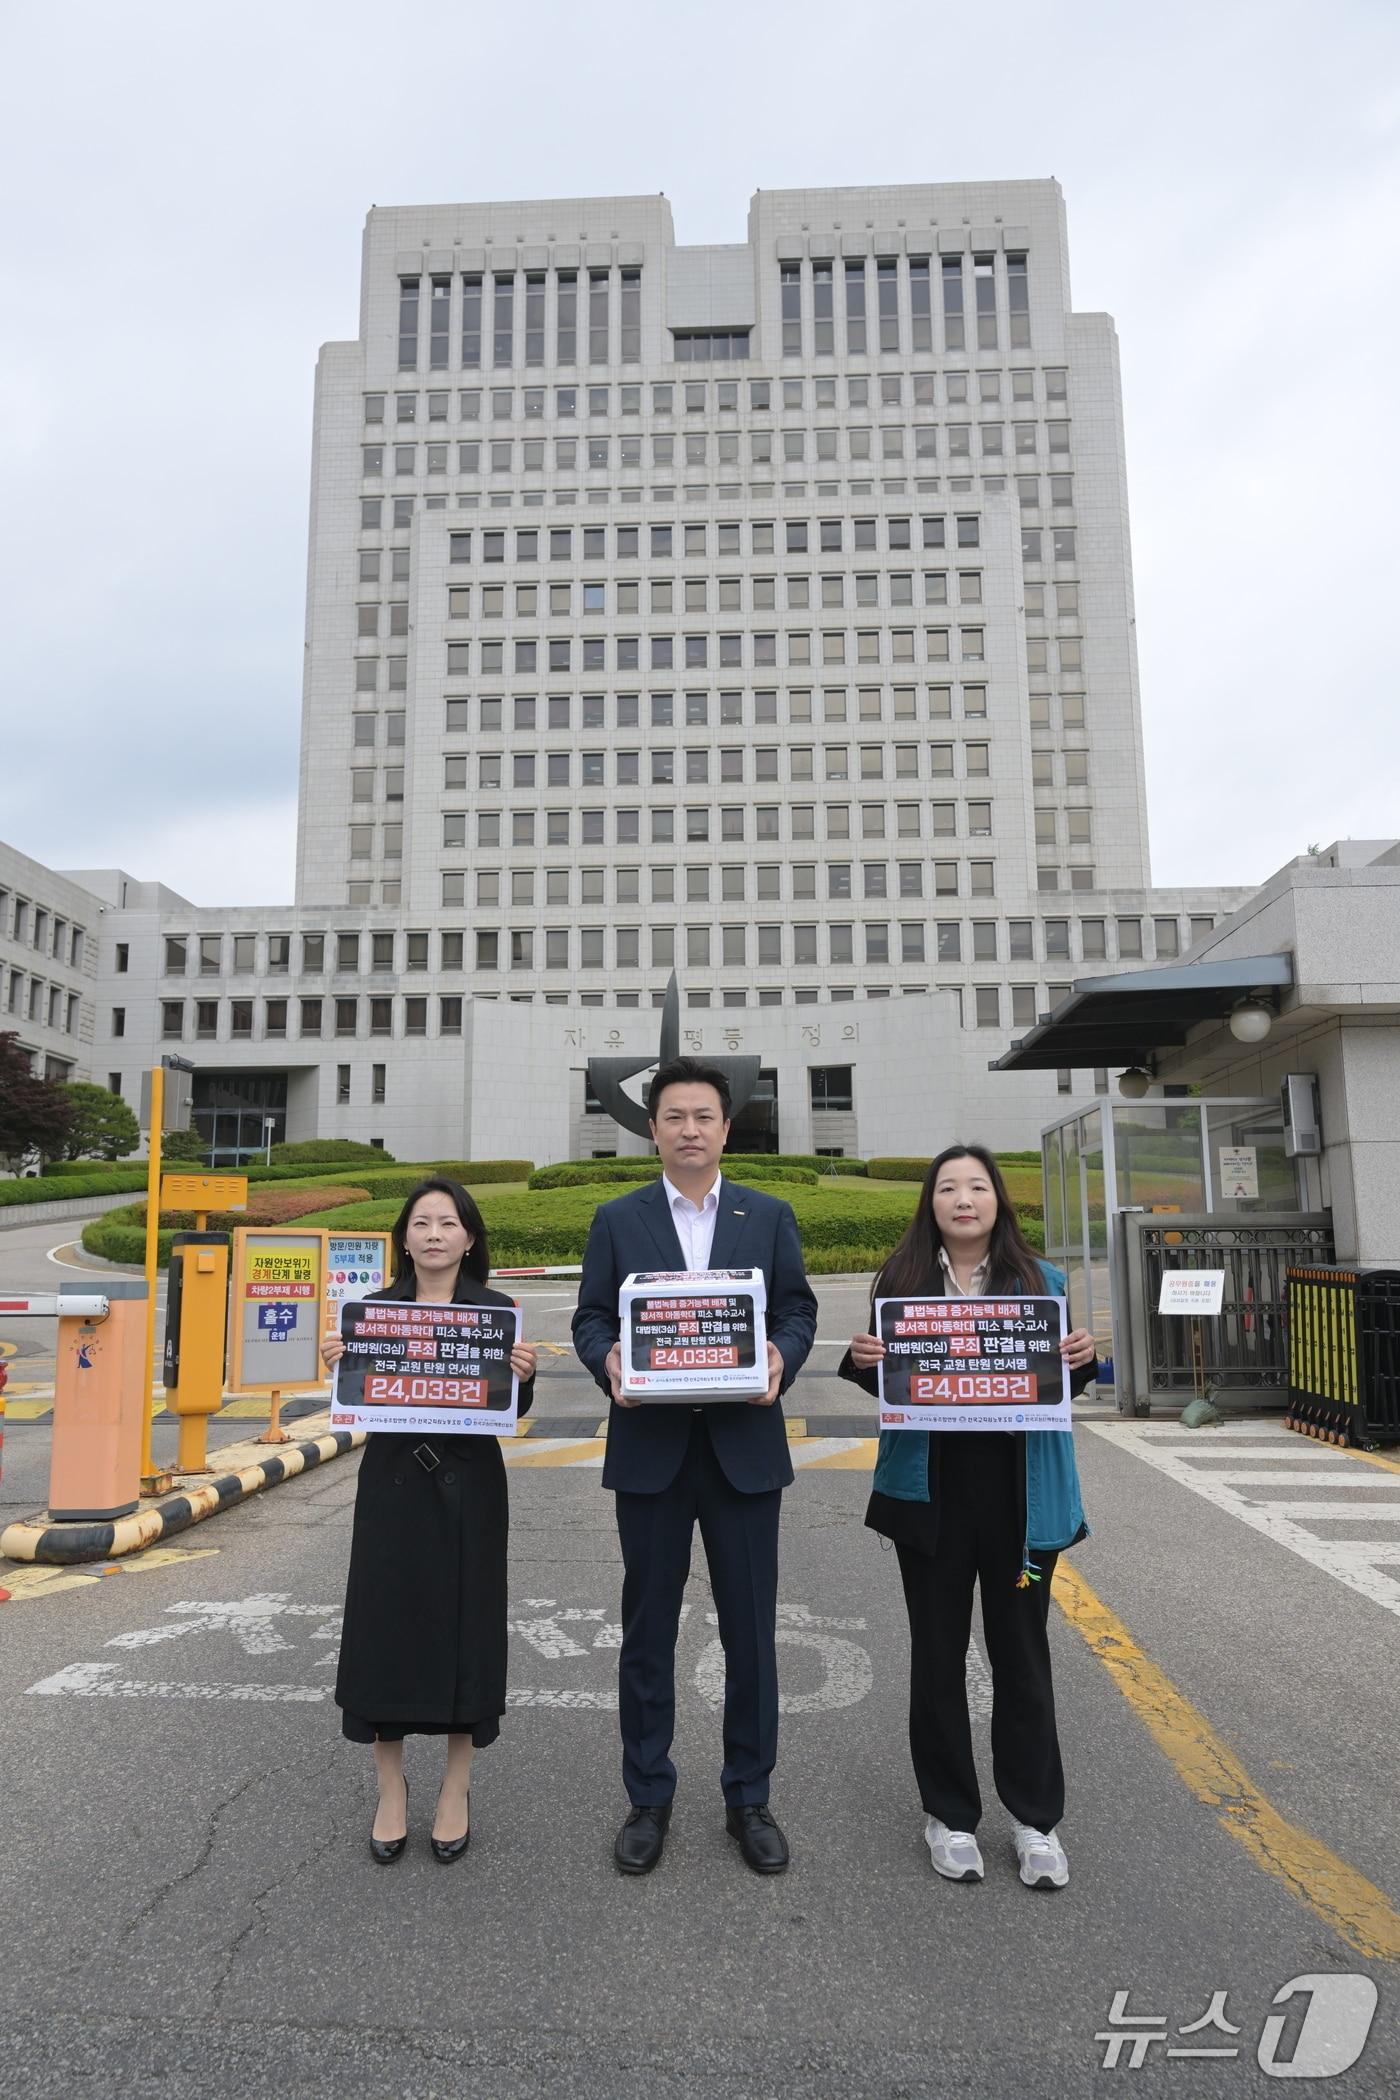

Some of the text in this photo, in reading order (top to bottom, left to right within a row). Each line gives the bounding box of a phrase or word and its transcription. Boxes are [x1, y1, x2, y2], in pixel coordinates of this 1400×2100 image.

[563, 1023, 859, 1051] 자유 평등 정의
[330, 1242, 378, 1251] 방문/민원 차량
[255, 1258, 310, 1268] 자원안보위기
[335, 1254, 373, 1263] 5부제 적용
[252, 1269, 311, 1280] 경계단계 발령
[252, 1285, 310, 1295] 차량2부제 시행
[647, 1299, 736, 1309] 불법녹음 증거능력 배제 및
[264, 1309, 293, 1324] 홀수
[364, 1307, 492, 1324] 불법녹음 증거능력 배제 및
[640, 1311, 663, 1320] 정서적
[665, 1311, 696, 1320] 아동학대
[715, 1309, 745, 1317] 특수교사
[904, 1304, 1034, 1318] 불법녹음 증거능력 배제 및
[355, 1323, 504, 1340] 정서적 아동학대 피소 특수교사
[636, 1321, 747, 1334] 대법원(3심) 무죄 판결을 위한
[895, 1320, 1048, 1333] 정서적 아동학대 피소 특수교사
[271, 1331, 285, 1340] 운행
[656, 1336, 731, 1346] 전국 교원 탄원 연서명
[347, 1341, 504, 1360] 대법원(3심) 무죄 판결을 위한
[889, 1337, 1050, 1354] 대법원(3심) 무죄 판결을 위한
[656, 1348, 733, 1366] 24,033건
[375, 1361, 480, 1375] 전국 교원 탄원 연서명
[919, 1359, 1027, 1371] 전국 교원 탄원 연서명
[371, 1378, 480, 1403] 24,033건
[918, 1377, 1030, 1401] 24,033건
